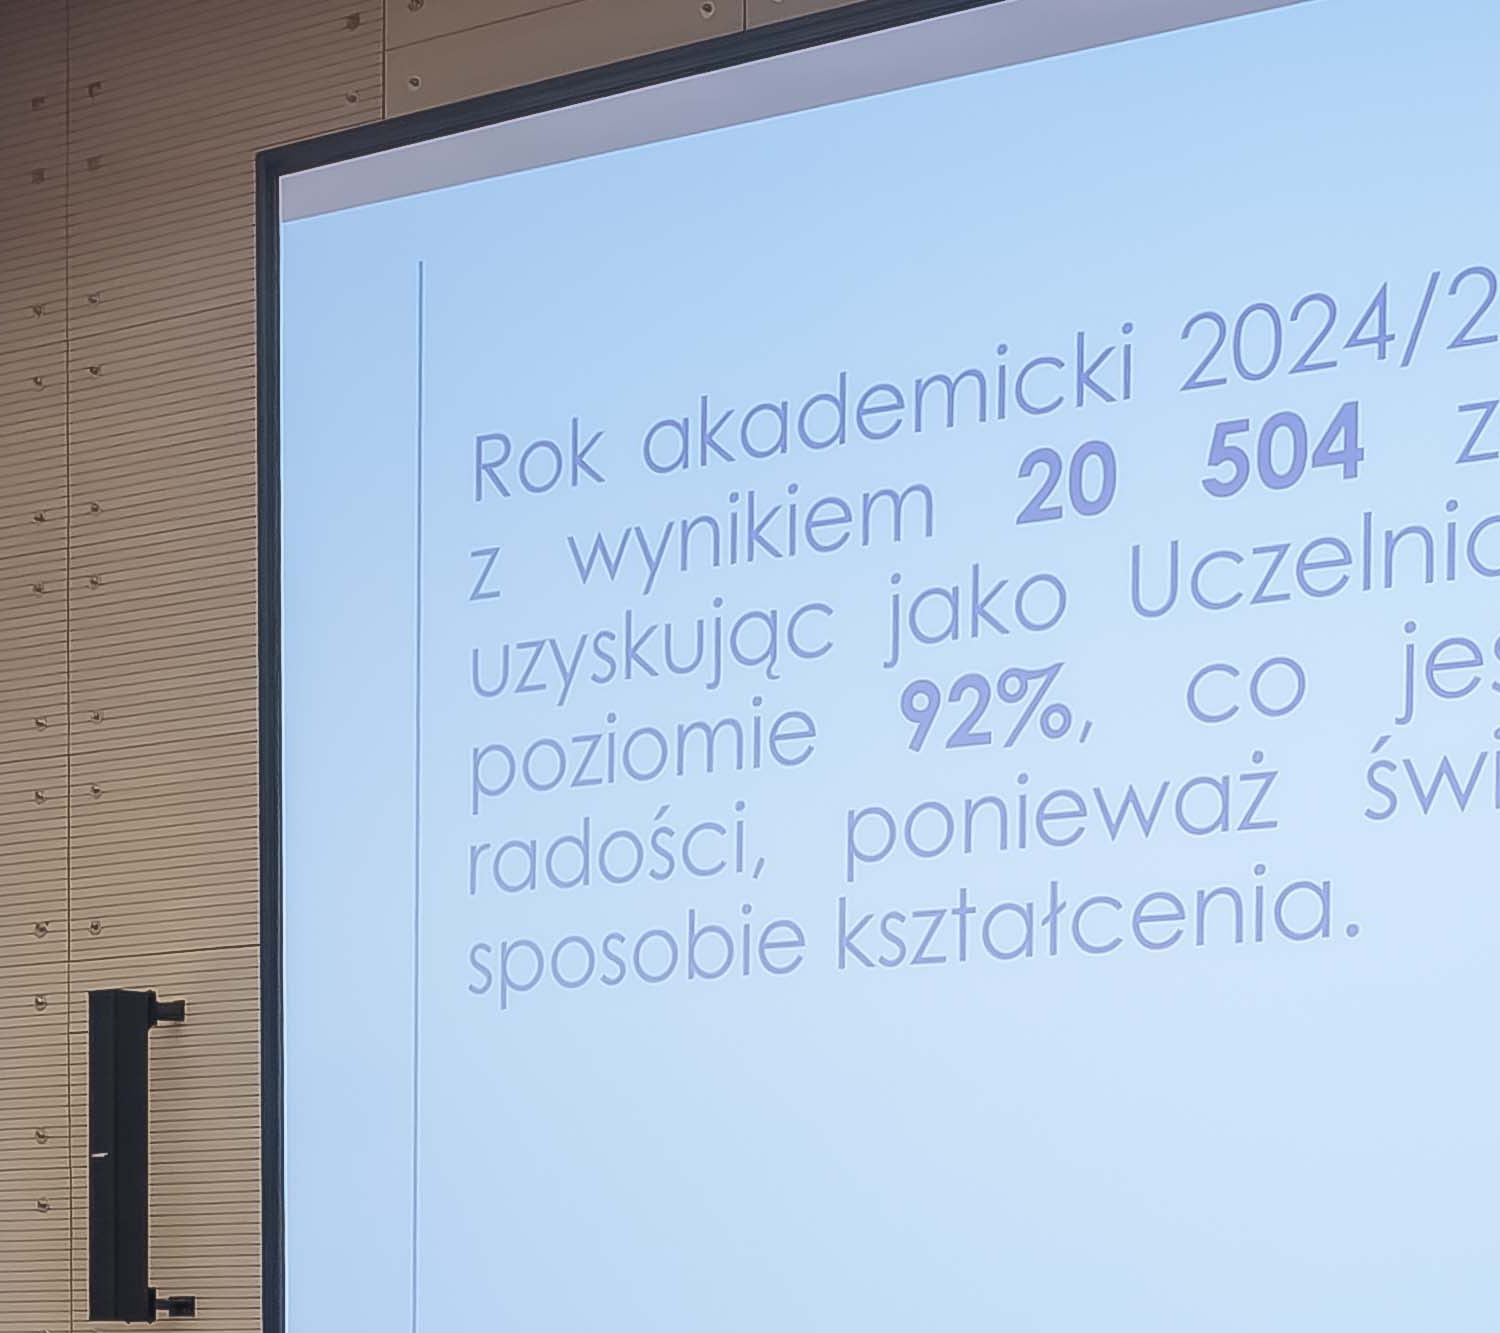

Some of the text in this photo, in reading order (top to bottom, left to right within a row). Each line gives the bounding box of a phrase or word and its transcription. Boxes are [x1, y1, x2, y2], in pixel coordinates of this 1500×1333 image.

[475, 416, 606, 503] Rok
[642, 321, 1134, 475] akademicki
[469, 546, 501, 602] z
[566, 482, 934, 597] wynikiem
[1015, 439, 1118, 526] 20
[1201, 399, 1365, 499] 504
[472, 596, 834, 708] uzyskując
[882, 562, 1068, 670] jako
[471, 695, 817, 816] poziomie
[899, 661, 1094, 753] 92%,
[1186, 656, 1307, 724] co
[469, 800, 765, 896] radości,
[846, 749, 1279, 883] ponieważ
[468, 863, 1360, 1011] sposobie kształcenia.
